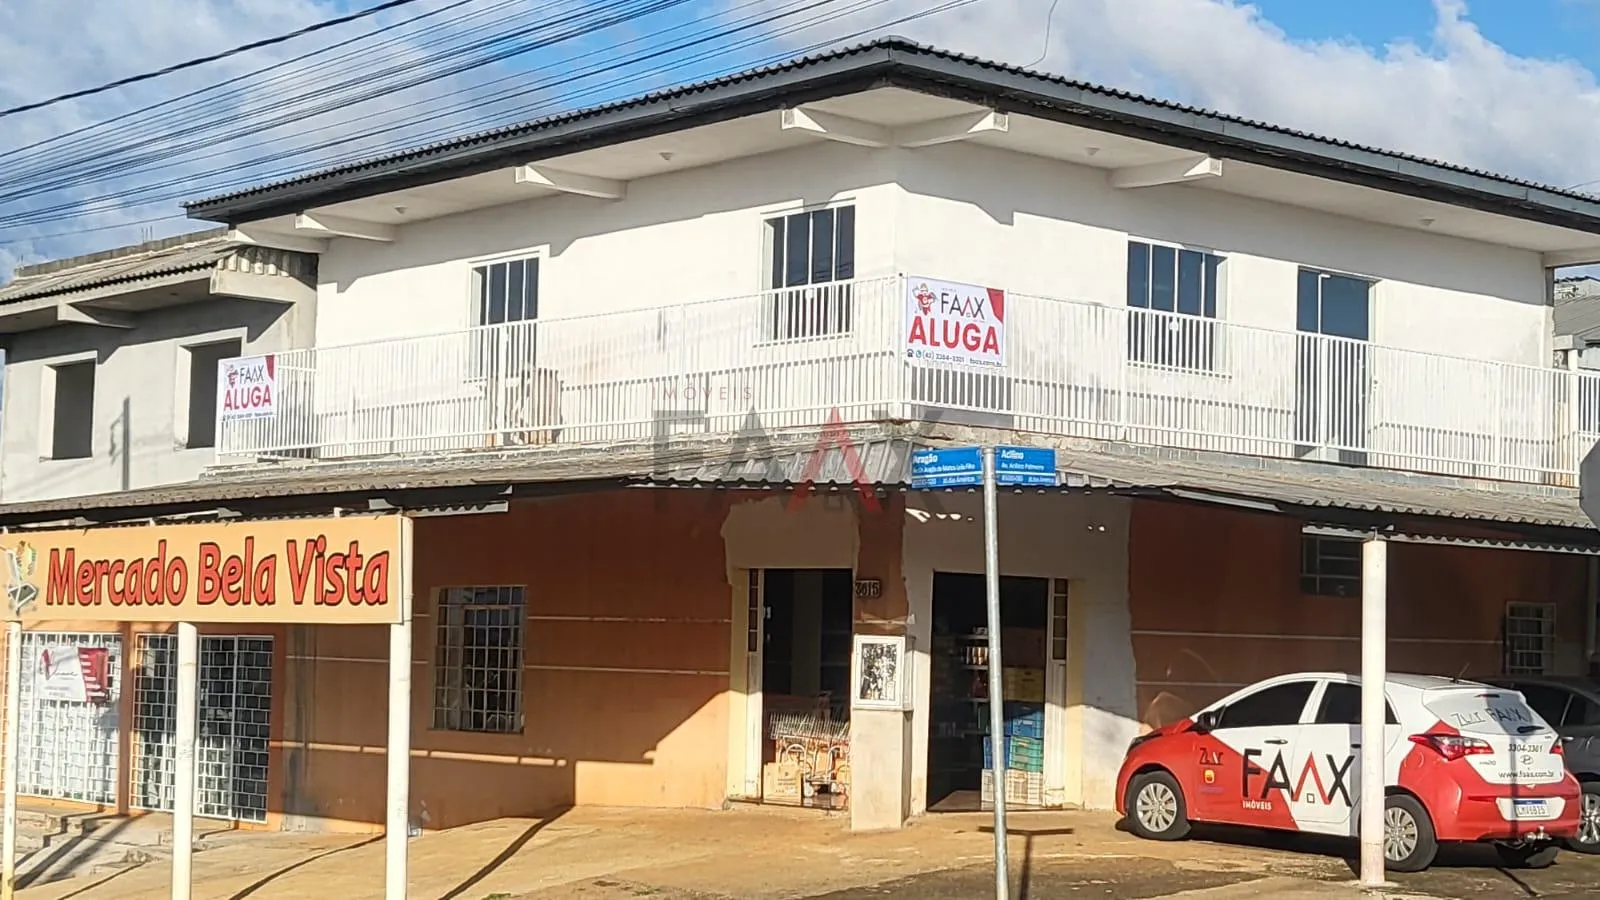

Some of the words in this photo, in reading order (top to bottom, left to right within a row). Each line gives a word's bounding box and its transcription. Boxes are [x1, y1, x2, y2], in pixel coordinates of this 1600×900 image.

[908, 315, 1000, 356] ALUGA
[223, 384, 272, 411] ALUGA
[46, 538, 189, 607] Mercado
[199, 535, 277, 607] Bela
[286, 533, 390, 607] Vista
[1242, 799, 1272, 811] IMÓVEIS
